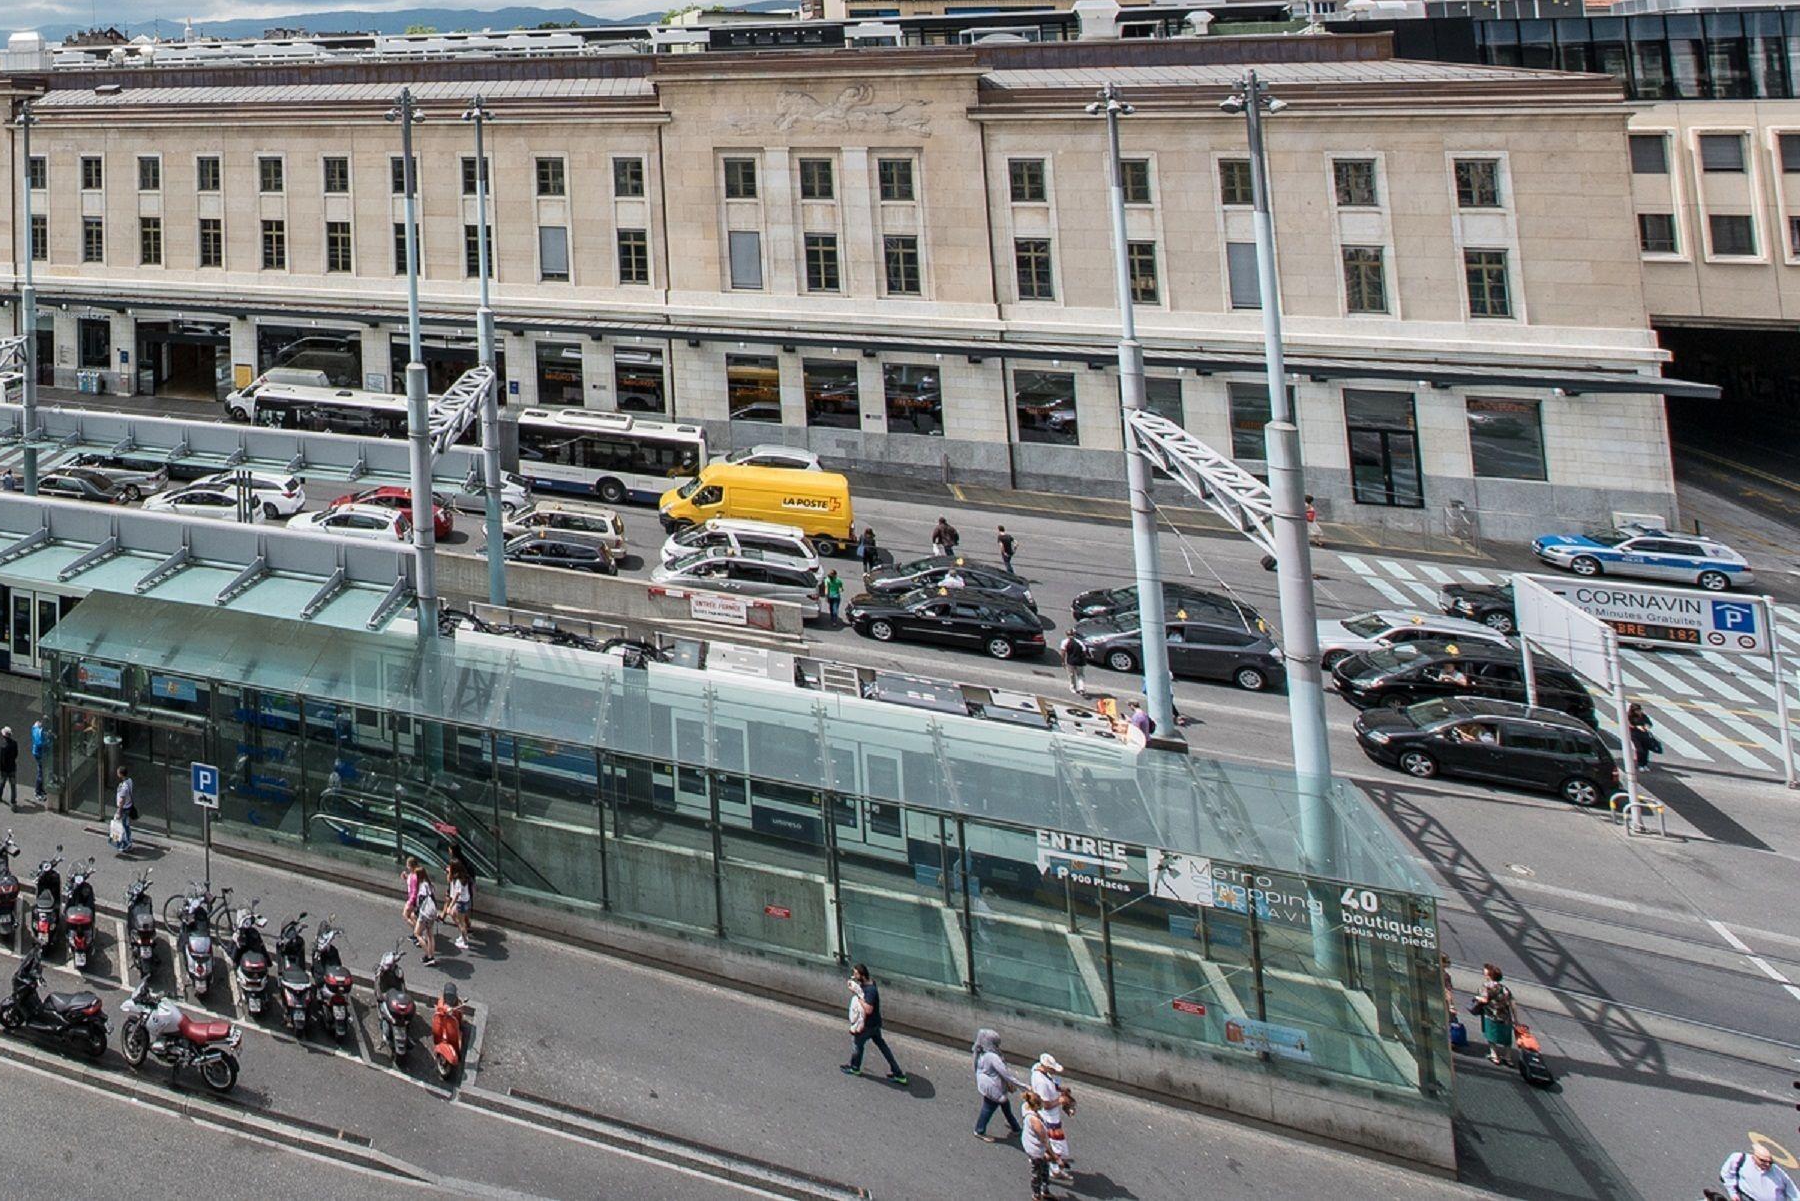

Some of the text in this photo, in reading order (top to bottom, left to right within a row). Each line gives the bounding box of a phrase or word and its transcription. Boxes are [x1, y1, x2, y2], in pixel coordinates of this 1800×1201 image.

[783, 498, 828, 508] LA POSTE
[1577, 588, 1701, 614] CORNAVIN
[1596, 607, 1642, 619] Minutes
[1647, 613, 1702, 626] Gratuites
[1725, 610, 1742, 628] P
[1669, 629, 1698, 642] 182
[200, 770, 211, 790] P
[1036, 829, 1128, 861] ENTREE
[1057, 865, 1131, 892] P 900 Places
[1189, 860, 1272, 887] Metro
[1191, 876, 1323, 916] Shopping
[1341, 888, 1378, 913] 40
[1342, 910, 1435, 938] boutiques
[1344, 926, 1437, 949] sous vos pieds
